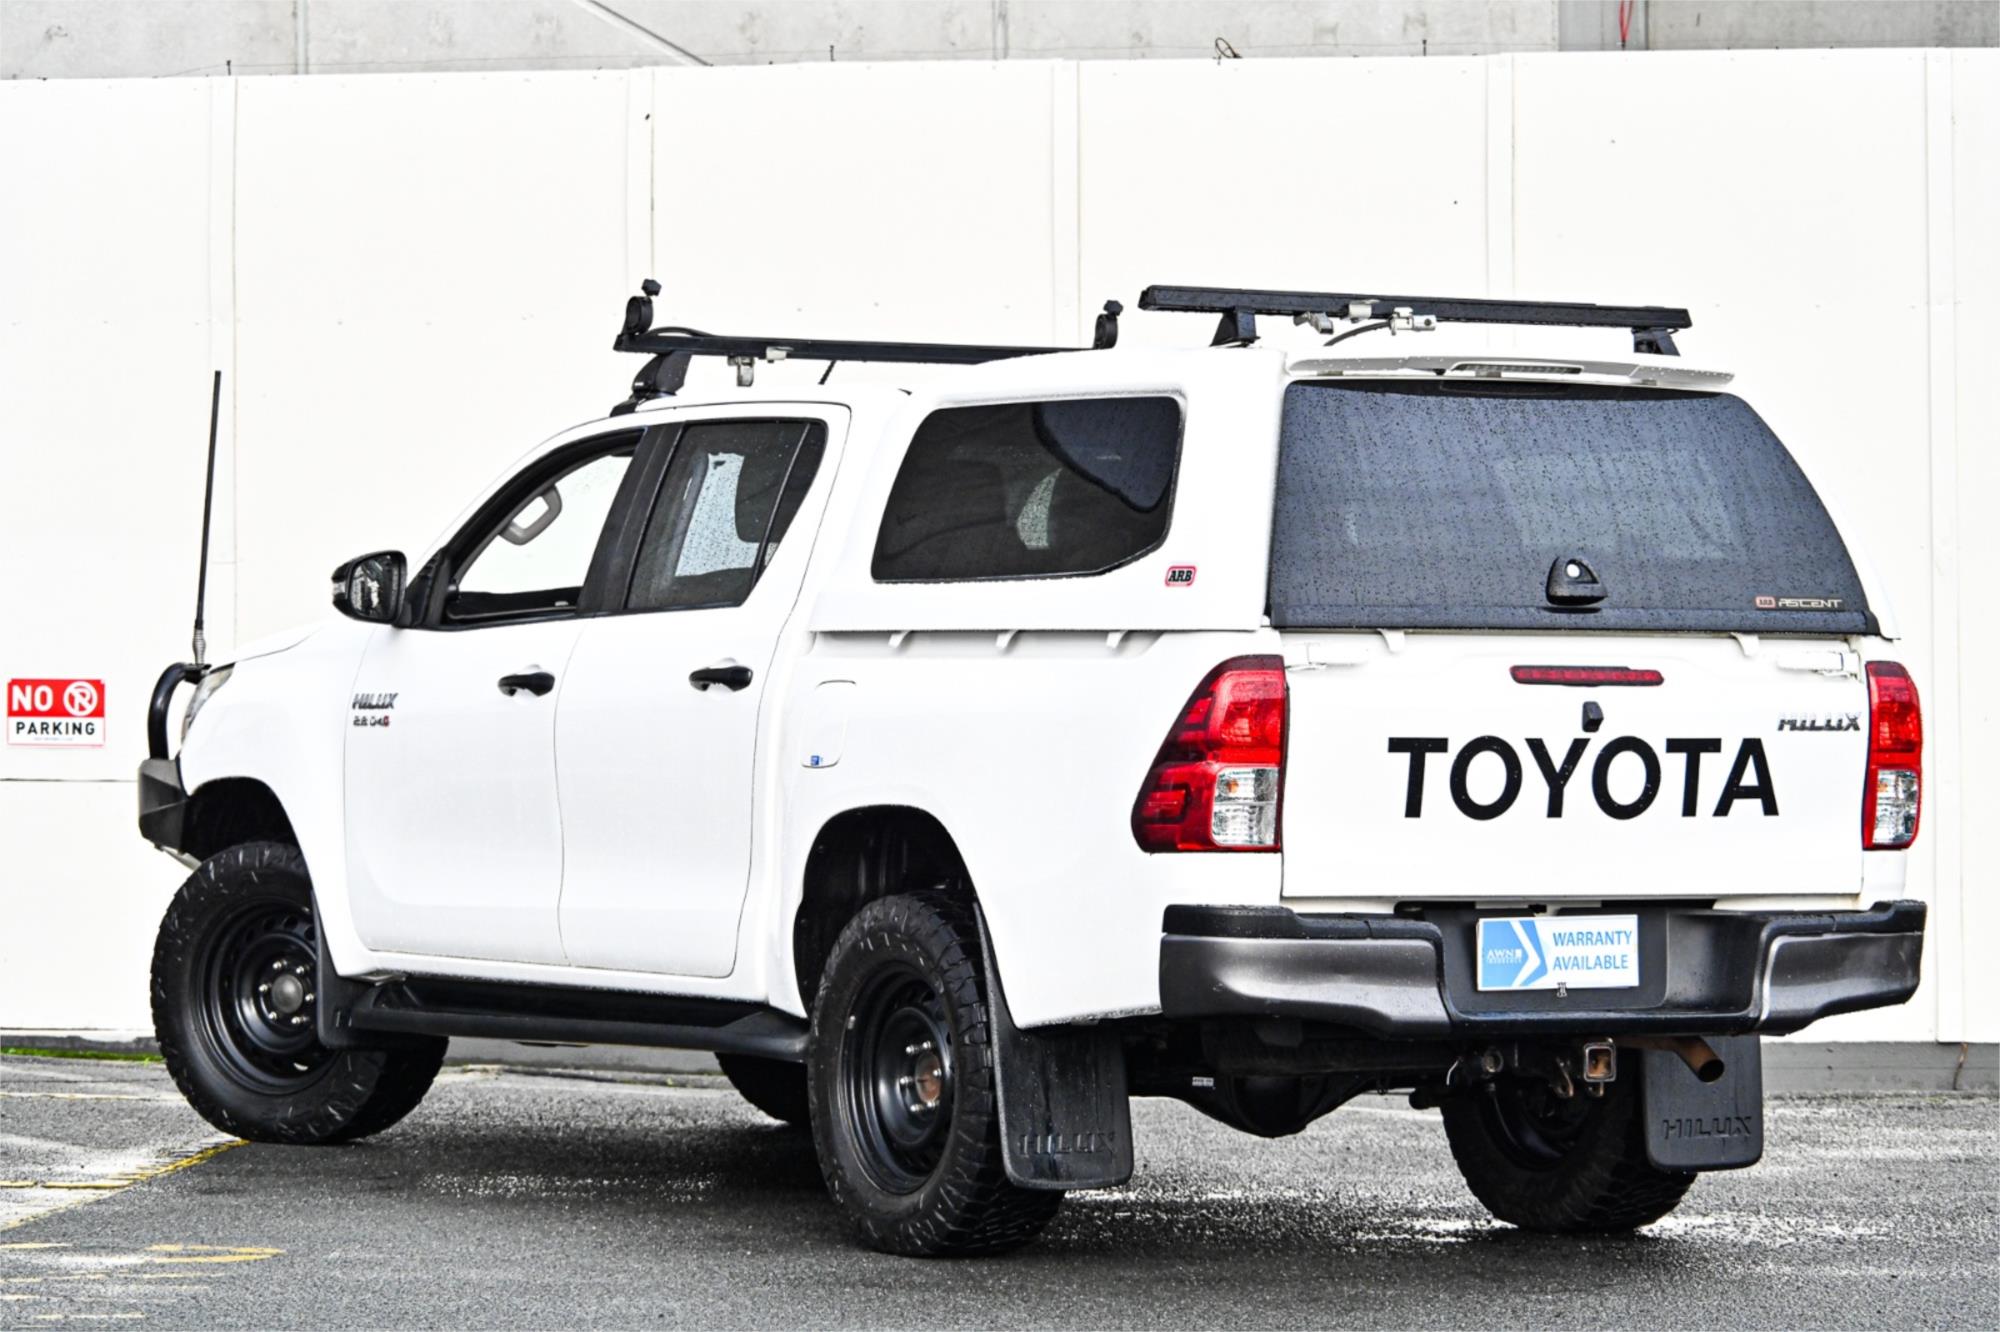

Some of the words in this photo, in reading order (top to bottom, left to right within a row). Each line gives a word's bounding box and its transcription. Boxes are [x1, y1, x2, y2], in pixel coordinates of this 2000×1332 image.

[1168, 569, 1192, 582] ARB
[1778, 598, 1843, 608] ASCENT
[12, 685, 54, 712] NO
[352, 692, 398, 710] HILUX
[16, 721, 96, 735] PARKING
[1777, 711, 1862, 731] HILUX
[1387, 735, 1779, 821] TOYOTA
[1552, 930, 1632, 947] WARRANTY
[1552, 954, 1630, 971] AVAILABLE
[1662, 1115, 1753, 1140] HILUX
[1018, 1132, 1117, 1156] HILUX
